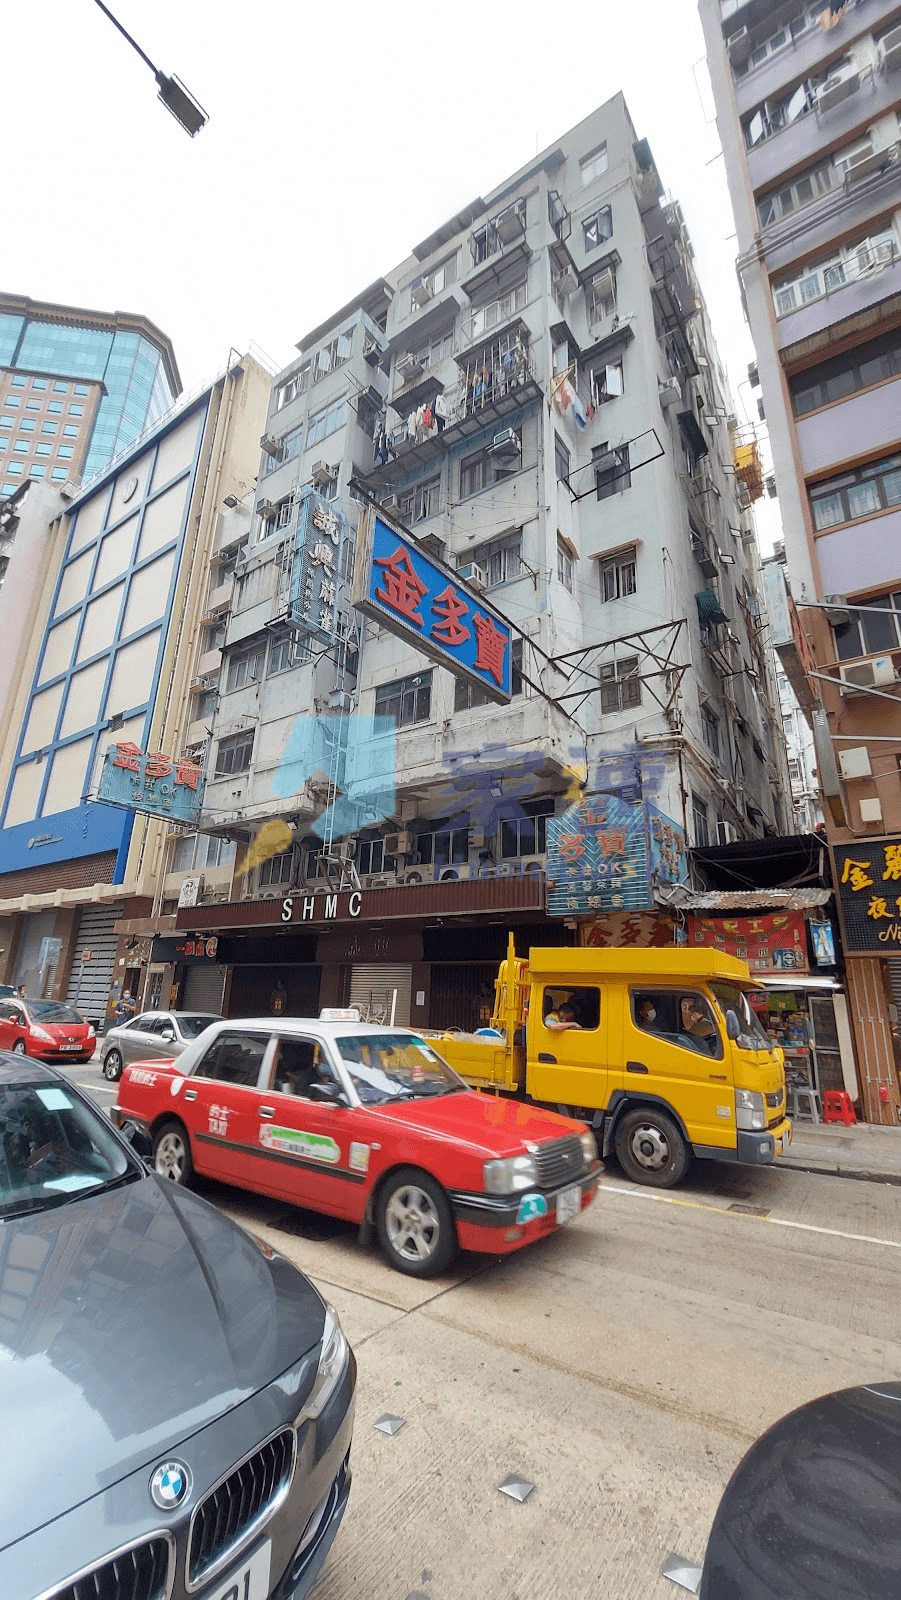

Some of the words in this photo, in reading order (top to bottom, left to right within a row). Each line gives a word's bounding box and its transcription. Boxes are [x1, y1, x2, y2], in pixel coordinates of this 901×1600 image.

[373, 543, 508, 685] 金多寶
[113, 741, 202, 791] 金多寶
[281, 891, 362, 922] SHMC
